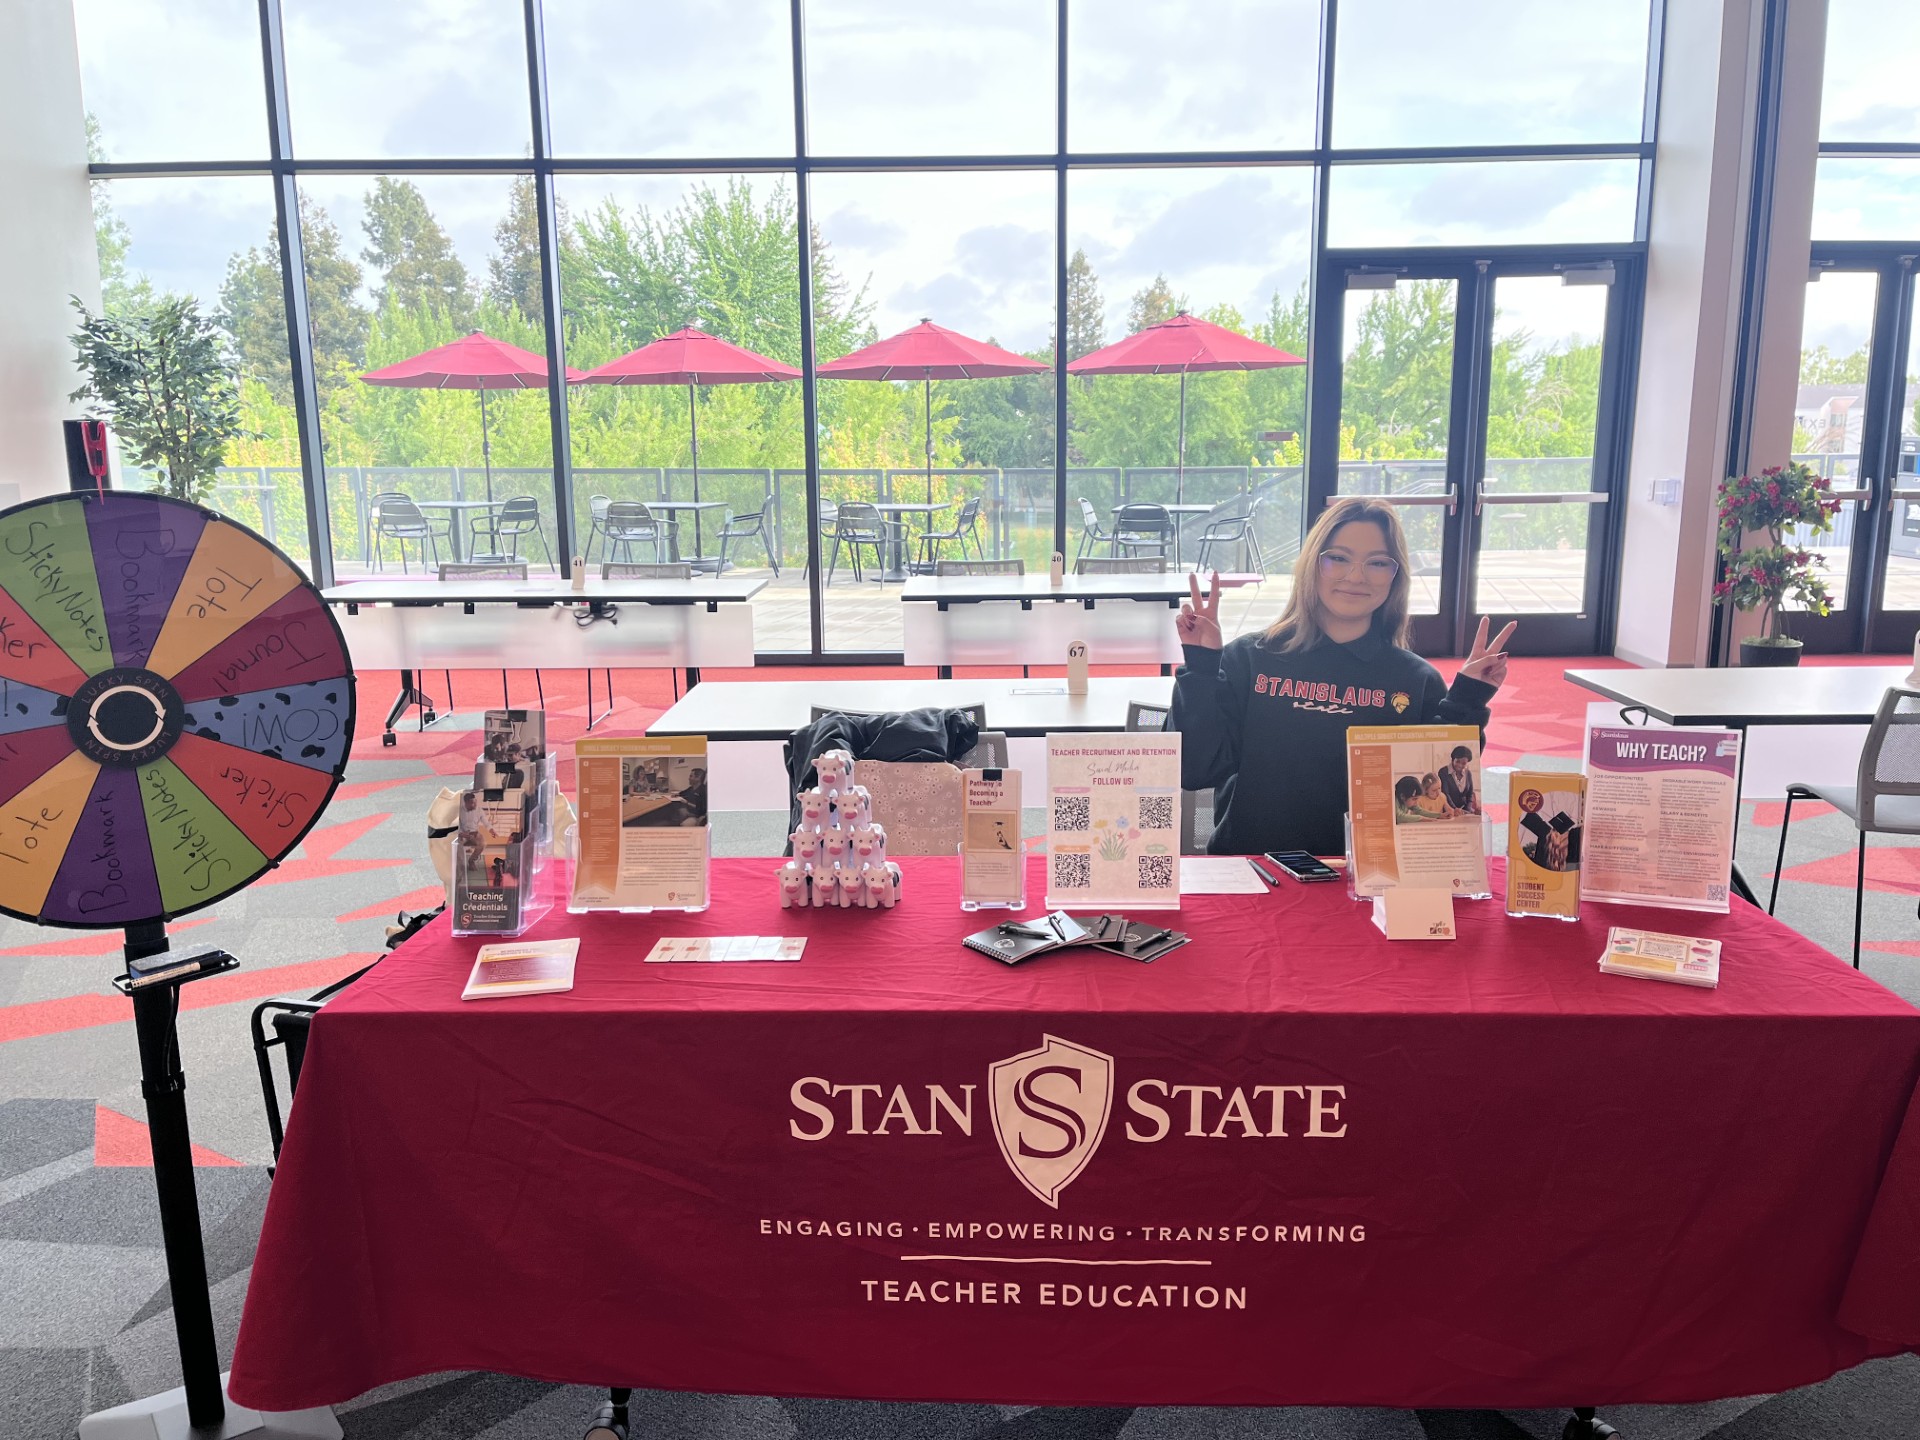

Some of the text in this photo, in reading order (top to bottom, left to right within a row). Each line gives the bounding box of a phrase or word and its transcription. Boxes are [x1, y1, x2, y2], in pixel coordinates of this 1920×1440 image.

[1051, 555, 1062, 563] 40
[5, 521, 104, 652] Sticky Notes
[116, 528, 176, 663] Bookmark
[187, 567, 262, 618] Tote
[213, 621, 327, 692] Journal
[1069, 646, 1085, 658] 67
[81, 674, 169, 704] LUCKY SPIN
[1254, 673, 1387, 708] STANISLAUS
[85, 731, 172, 762] LUCKY SPIN
[1051, 748, 1080, 756] TEACHER
[1081, 748, 1125, 756] RECRUITMENT
[1142, 748, 1177, 756] RETENTION
[1616, 742, 1707, 762] WHY TEACH?
[969, 780, 994, 788] Pathway
[1092, 777, 1134, 785] FOLLOW US!
[220, 767, 308, 828] Sticker
[146, 769, 231, 892] Sticky Notes
[78, 790, 129, 914] Bookmark
[468, 892, 504, 902] Teaching
[1517, 882, 1545, 891] STUDENT
[1517, 890, 1545, 900] SUCCESS
[462, 903, 508, 911] Credentials
[1516, 899, 1540, 909] CENTER
[788, 1076, 978, 1142] STAN
[1125, 1078, 1348, 1144] STATE
[759, 1218, 1367, 1244] ENGAGING EMPOWERING TRANSFORMING
[861, 1279, 1248, 1311] TEACHER EDUCATION
